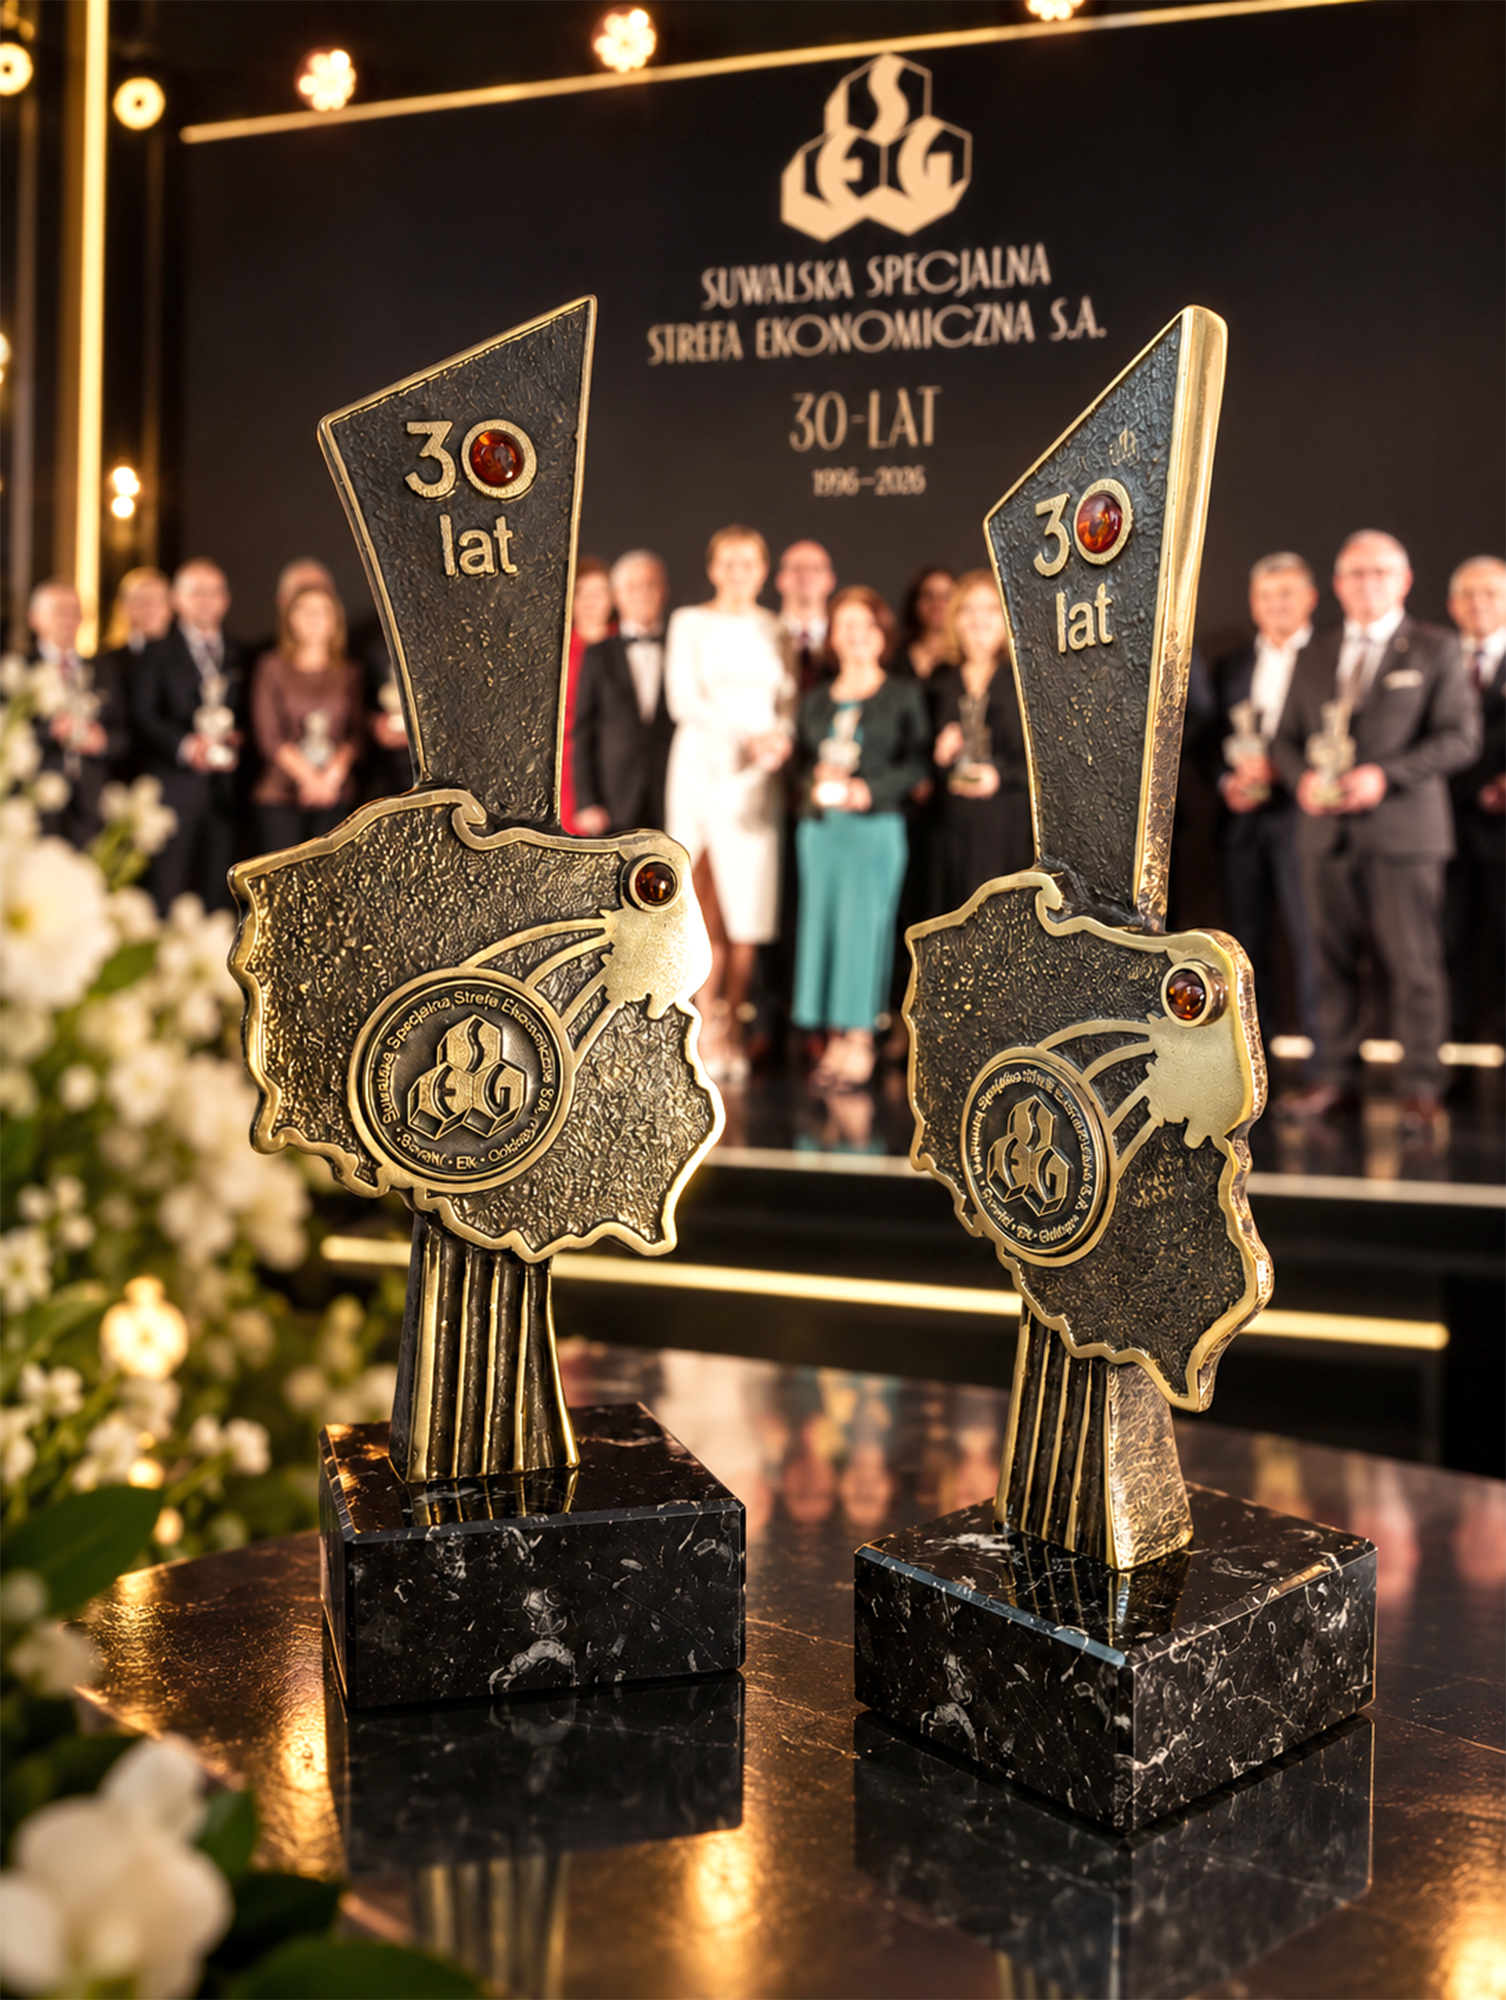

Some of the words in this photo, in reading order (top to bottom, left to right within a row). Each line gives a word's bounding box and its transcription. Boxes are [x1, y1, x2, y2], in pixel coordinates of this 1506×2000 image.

[701, 258, 854, 311] SUWALSKA
[866, 242, 1052, 298] SPECJALNA
[647, 319, 744, 366] STREFA
[755, 301, 1036, 359] EKONOMICZNA
[1049, 295, 1107, 341] S.A.
[789, 386, 943, 452] 30-LAT
[404, 419, 537, 499] 30
[440, 514, 518, 577] lat
[1034, 478, 1133, 577] 30
[1056, 583, 1113, 653] lat
